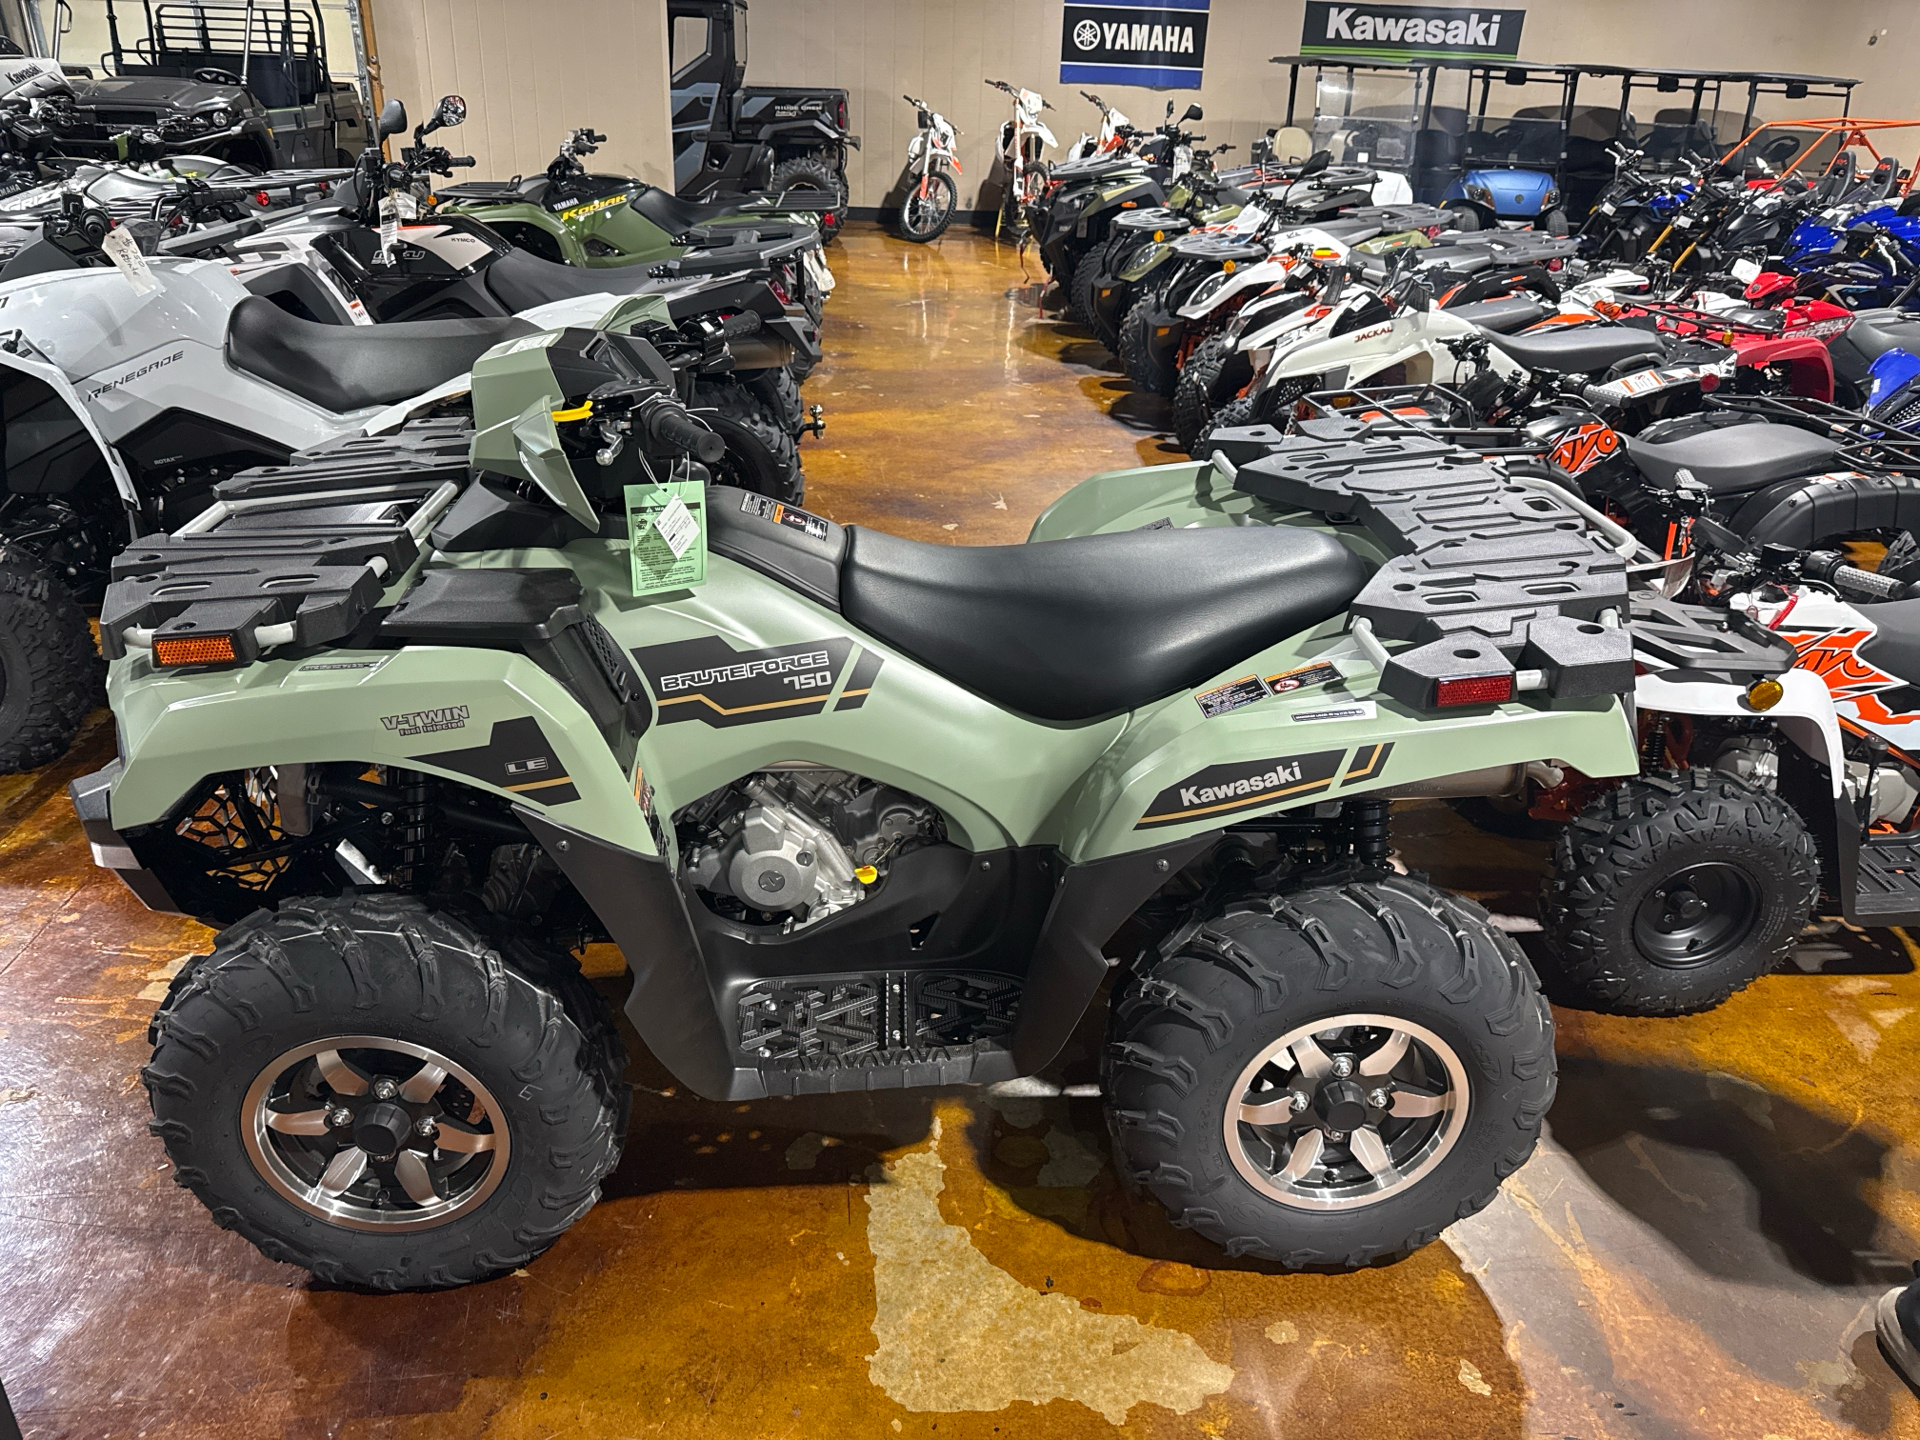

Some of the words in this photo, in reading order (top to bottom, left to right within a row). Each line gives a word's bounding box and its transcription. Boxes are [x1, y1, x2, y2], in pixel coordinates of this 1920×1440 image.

[1326, 7, 1501, 46] Kawasaki
[1102, 22, 1194, 54] YAMAHA
[5, 63, 43, 86] Kawasaki
[0, 184, 21, 197] MAHA
[553, 197, 579, 211] YAMAHA
[562, 194, 628, 221] KODIAK
[1354, 324, 1394, 343] JACKAL
[88, 351, 184, 402] RENEGADE
[153, 457, 175, 466] ROTAX
[783, 671, 832, 690] 750
[380, 705, 470, 730] V-TWIN
[399, 726, 422, 736] Fuel
[423, 719, 465, 733] Injected
[507, 758, 548, 774] LE
[1180, 761, 1302, 806] Kawasaki
